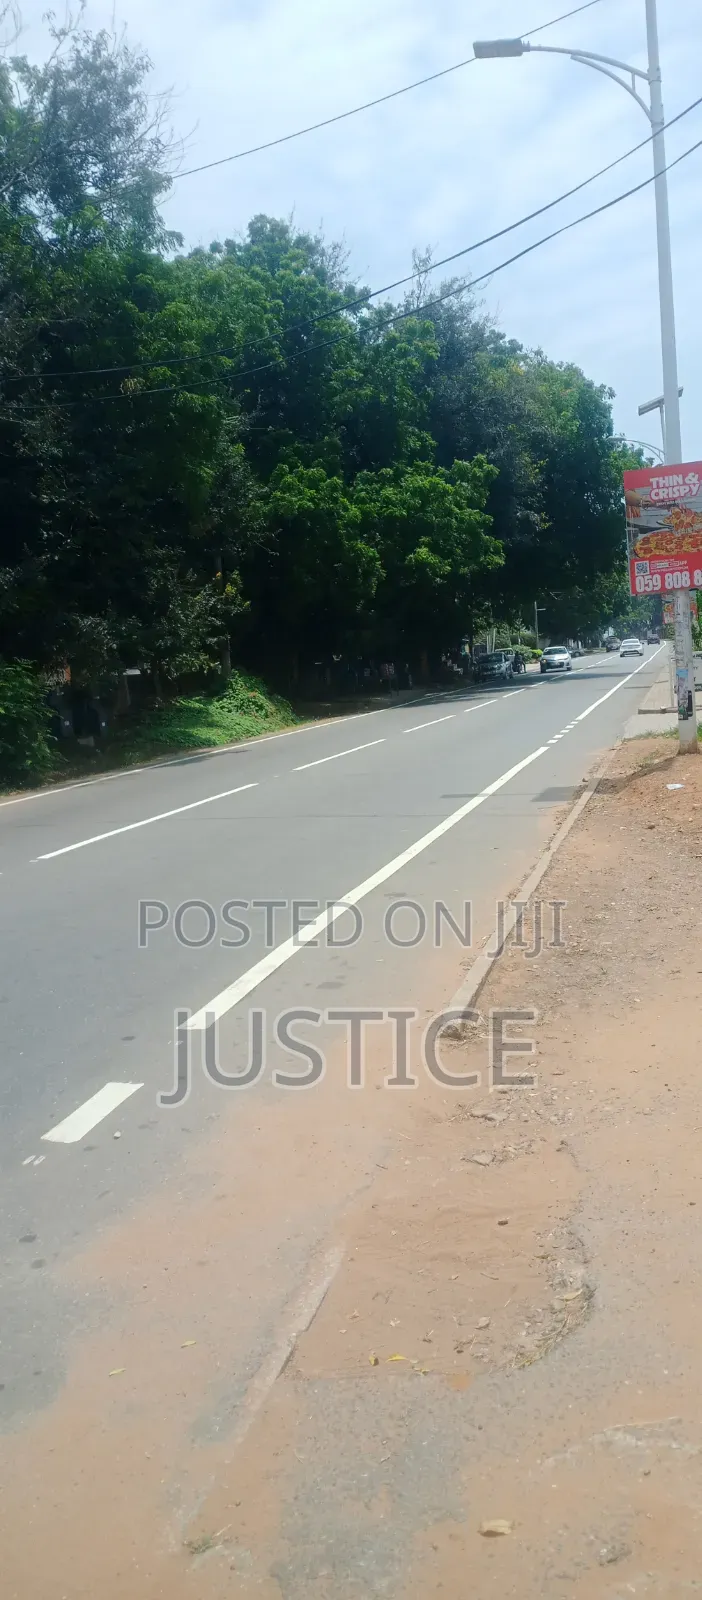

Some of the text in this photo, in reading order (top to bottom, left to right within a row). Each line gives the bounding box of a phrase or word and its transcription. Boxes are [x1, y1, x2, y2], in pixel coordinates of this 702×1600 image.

[649, 472, 700, 488] THIN &
[650, 484, 700, 500] CRISPY
[635, 574, 661, 592] 059
[665, 571, 690, 589] 808
